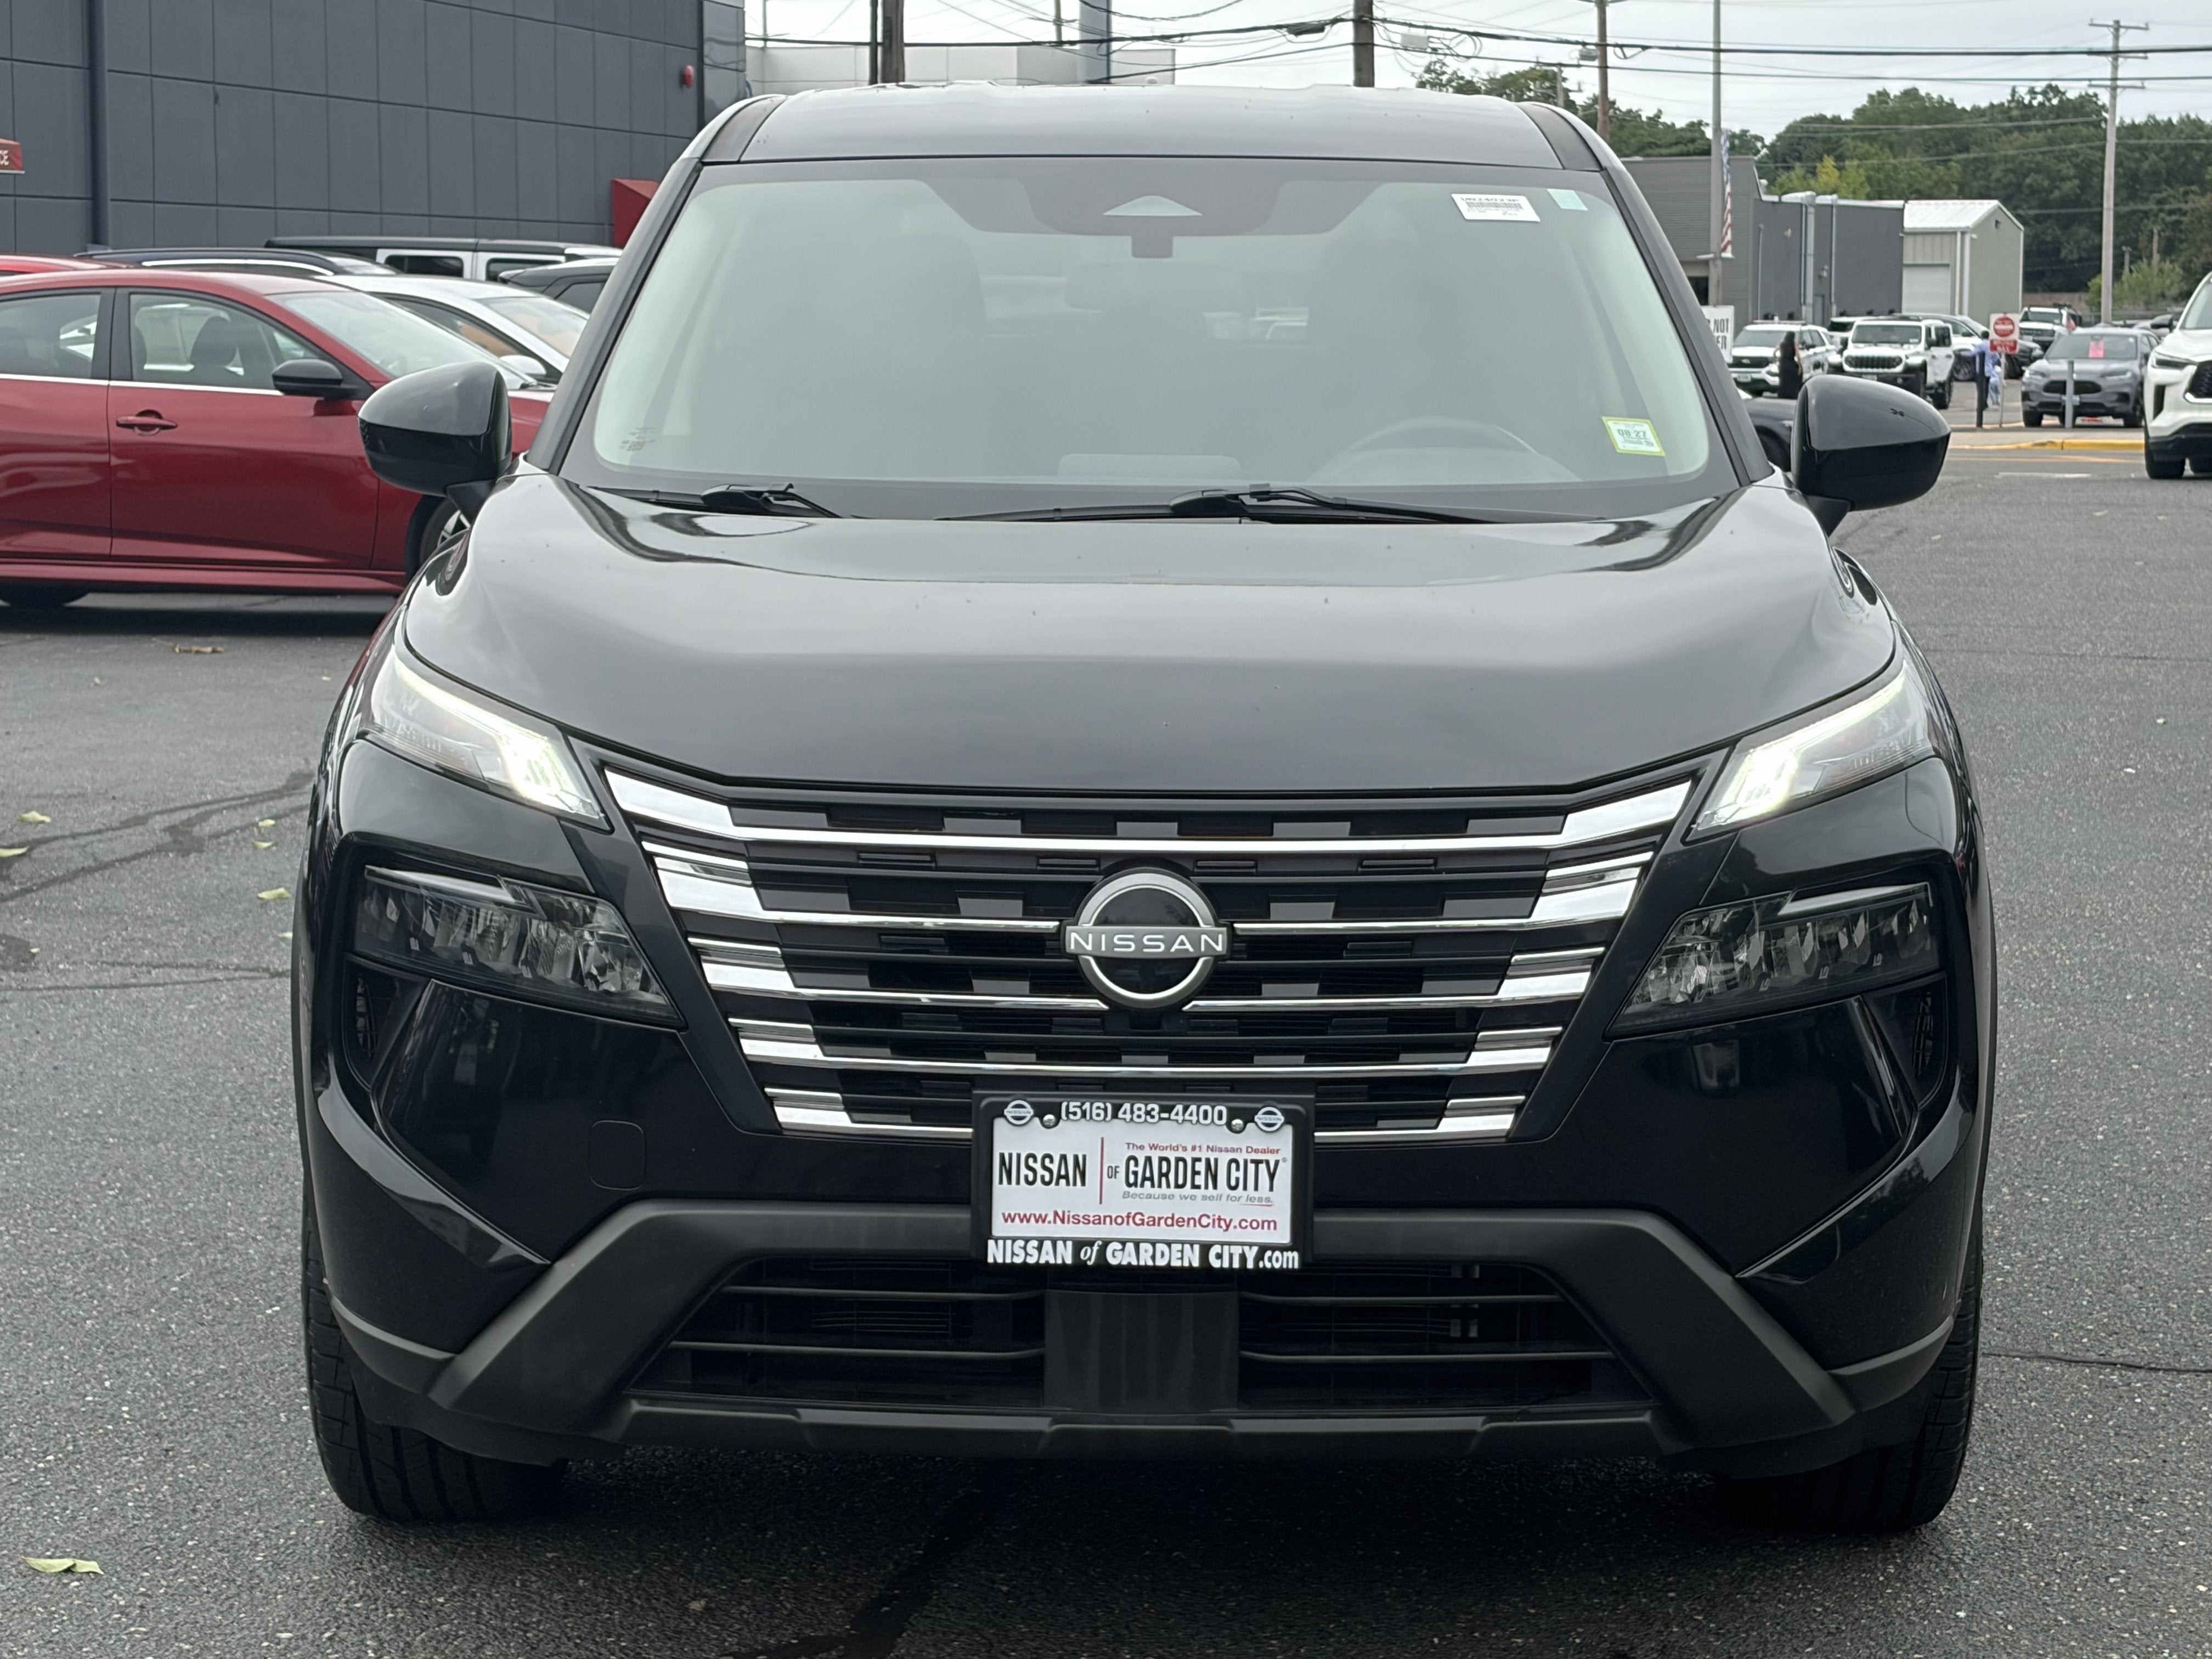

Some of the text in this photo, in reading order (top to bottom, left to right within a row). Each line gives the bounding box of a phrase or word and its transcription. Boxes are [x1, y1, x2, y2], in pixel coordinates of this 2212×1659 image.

[1713, 318, 1729, 334] NOT
[1070, 932, 1223, 953] NISSAN
[1061, 1101, 1227, 1125] (516) 483-4400
[1125, 1142, 1145, 1151] The
[1148, 1143, 1188, 1152] World's
[1206, 1145, 1242, 1153] Nissan
[1246, 1146, 1280, 1155] Dealer
[998, 1152, 1280, 1192] NISSAN OF GARDEN CITY
[1122, 1191, 1175, 1200] Because
[1201, 1193, 1222, 1201] sell
[1226, 1193, 1242, 1203] for
[1245, 1194, 1273, 1204] less.
[1001, 1210, 1277, 1233] www.NissanofGardenCity.com
[987, 1239, 1299, 1269] NISSAN of GARDEN CITY.com
